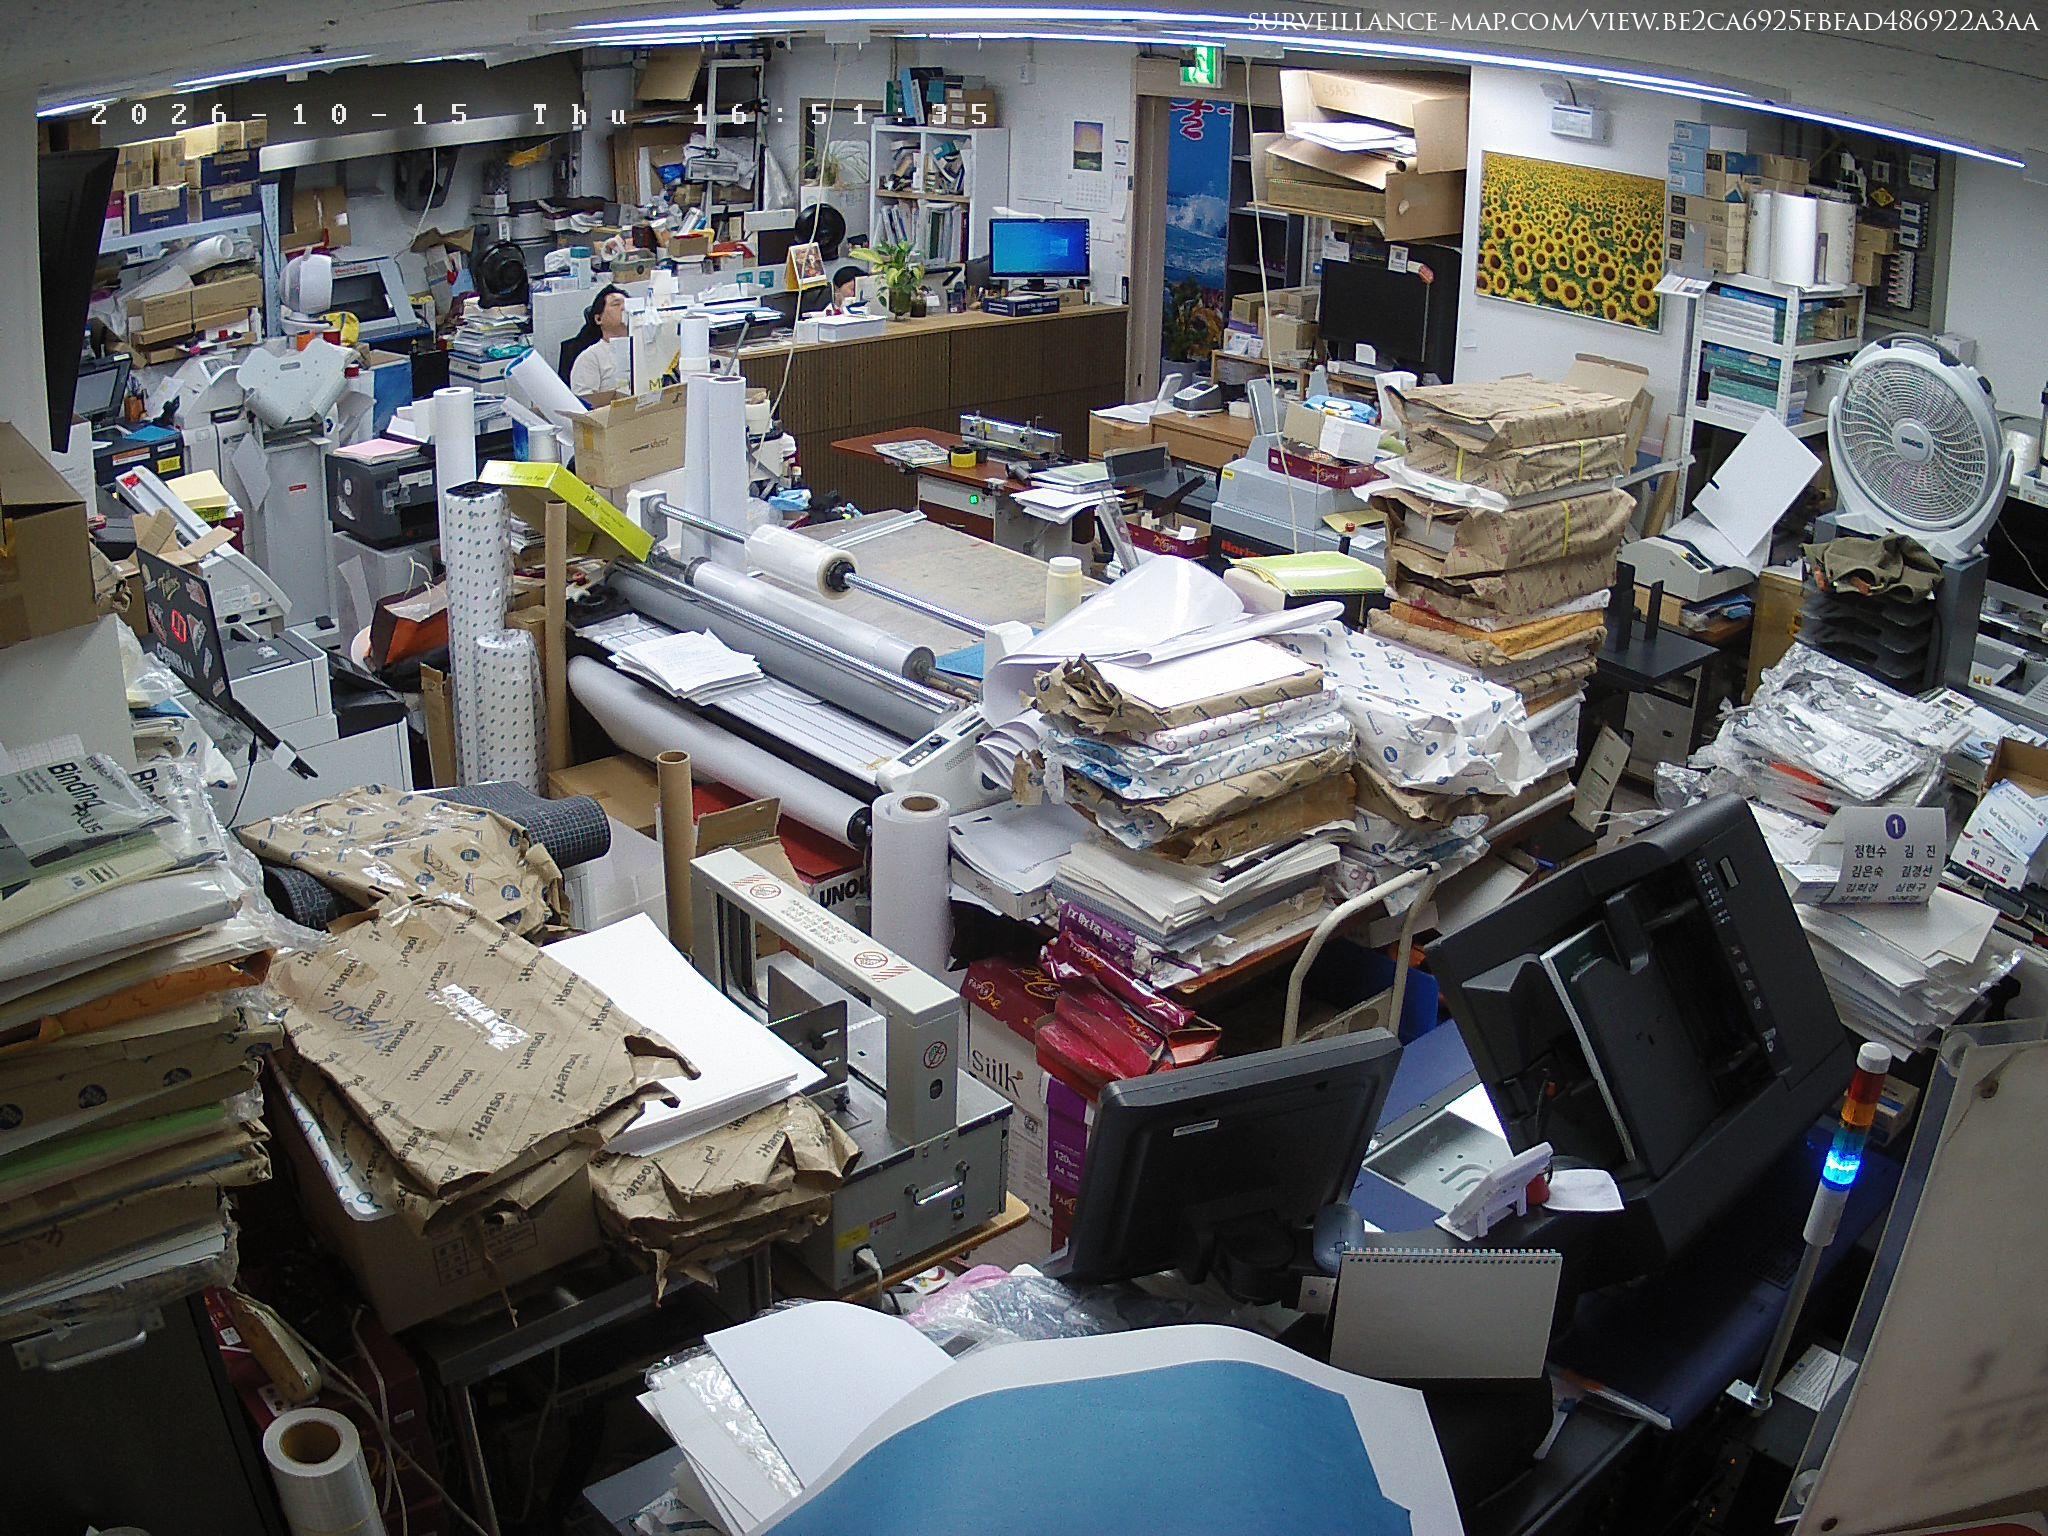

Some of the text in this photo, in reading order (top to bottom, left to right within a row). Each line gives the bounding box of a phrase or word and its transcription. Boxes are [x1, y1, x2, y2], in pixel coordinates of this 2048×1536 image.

[48, 761, 107, 808] Binding
[1891, 819, 1901, 835] 1
[407, 1045, 445, 1082] Hansol
[436, 1069, 476, 1106] Hansol
[468, 1091, 507, 1141] Hansol
